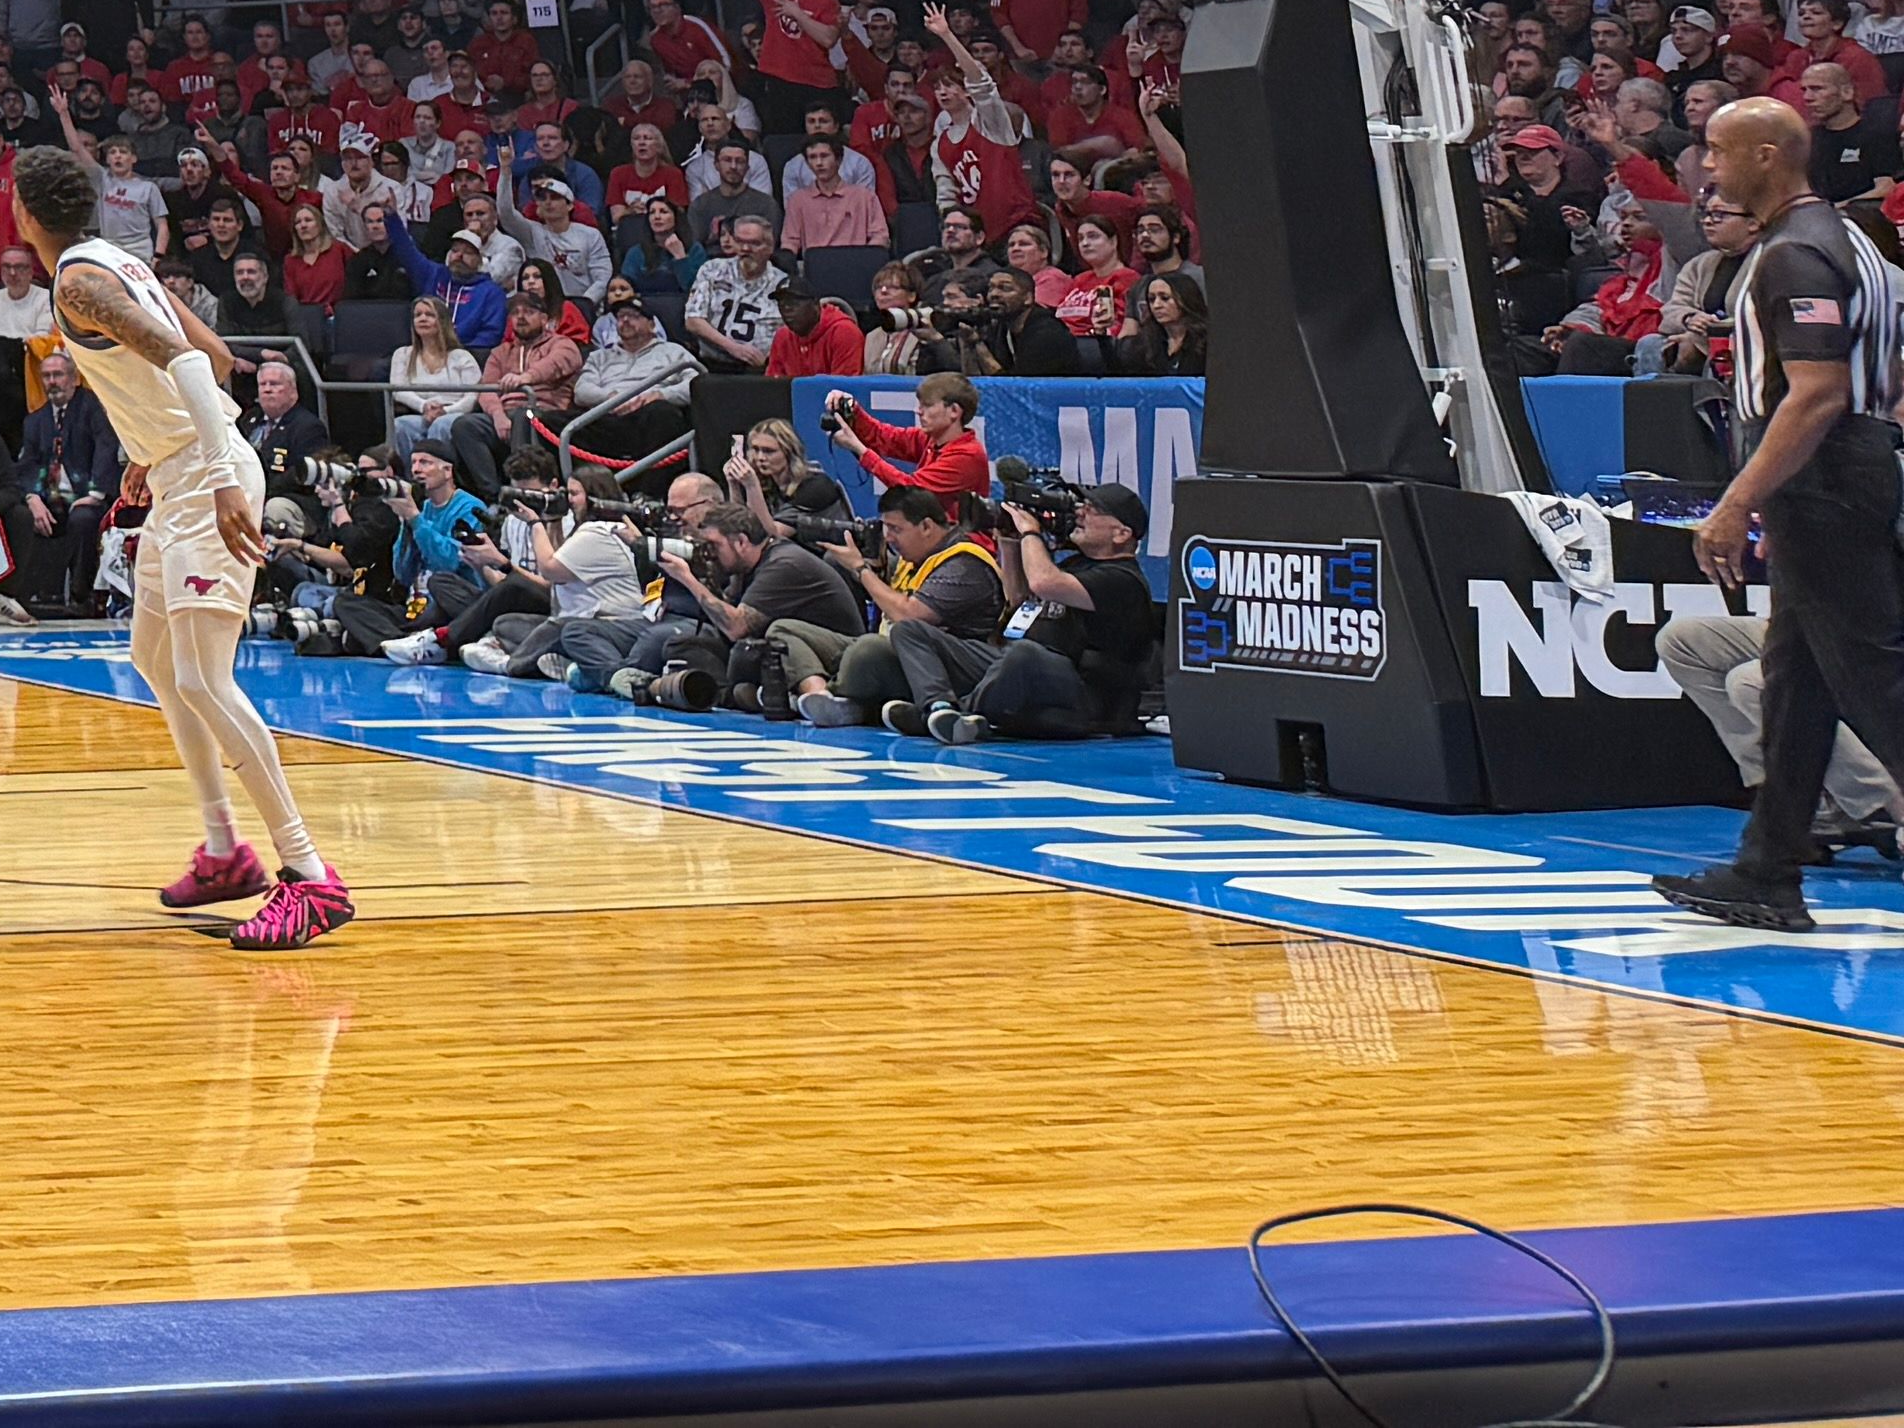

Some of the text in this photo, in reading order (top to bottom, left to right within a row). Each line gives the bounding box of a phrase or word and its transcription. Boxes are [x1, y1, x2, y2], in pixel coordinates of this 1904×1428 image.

[533, 5, 552, 18] 115
[719, 298, 763, 344] 15
[1218, 548, 1323, 604] MARCH
[1236, 600, 1383, 659] MADNESS
